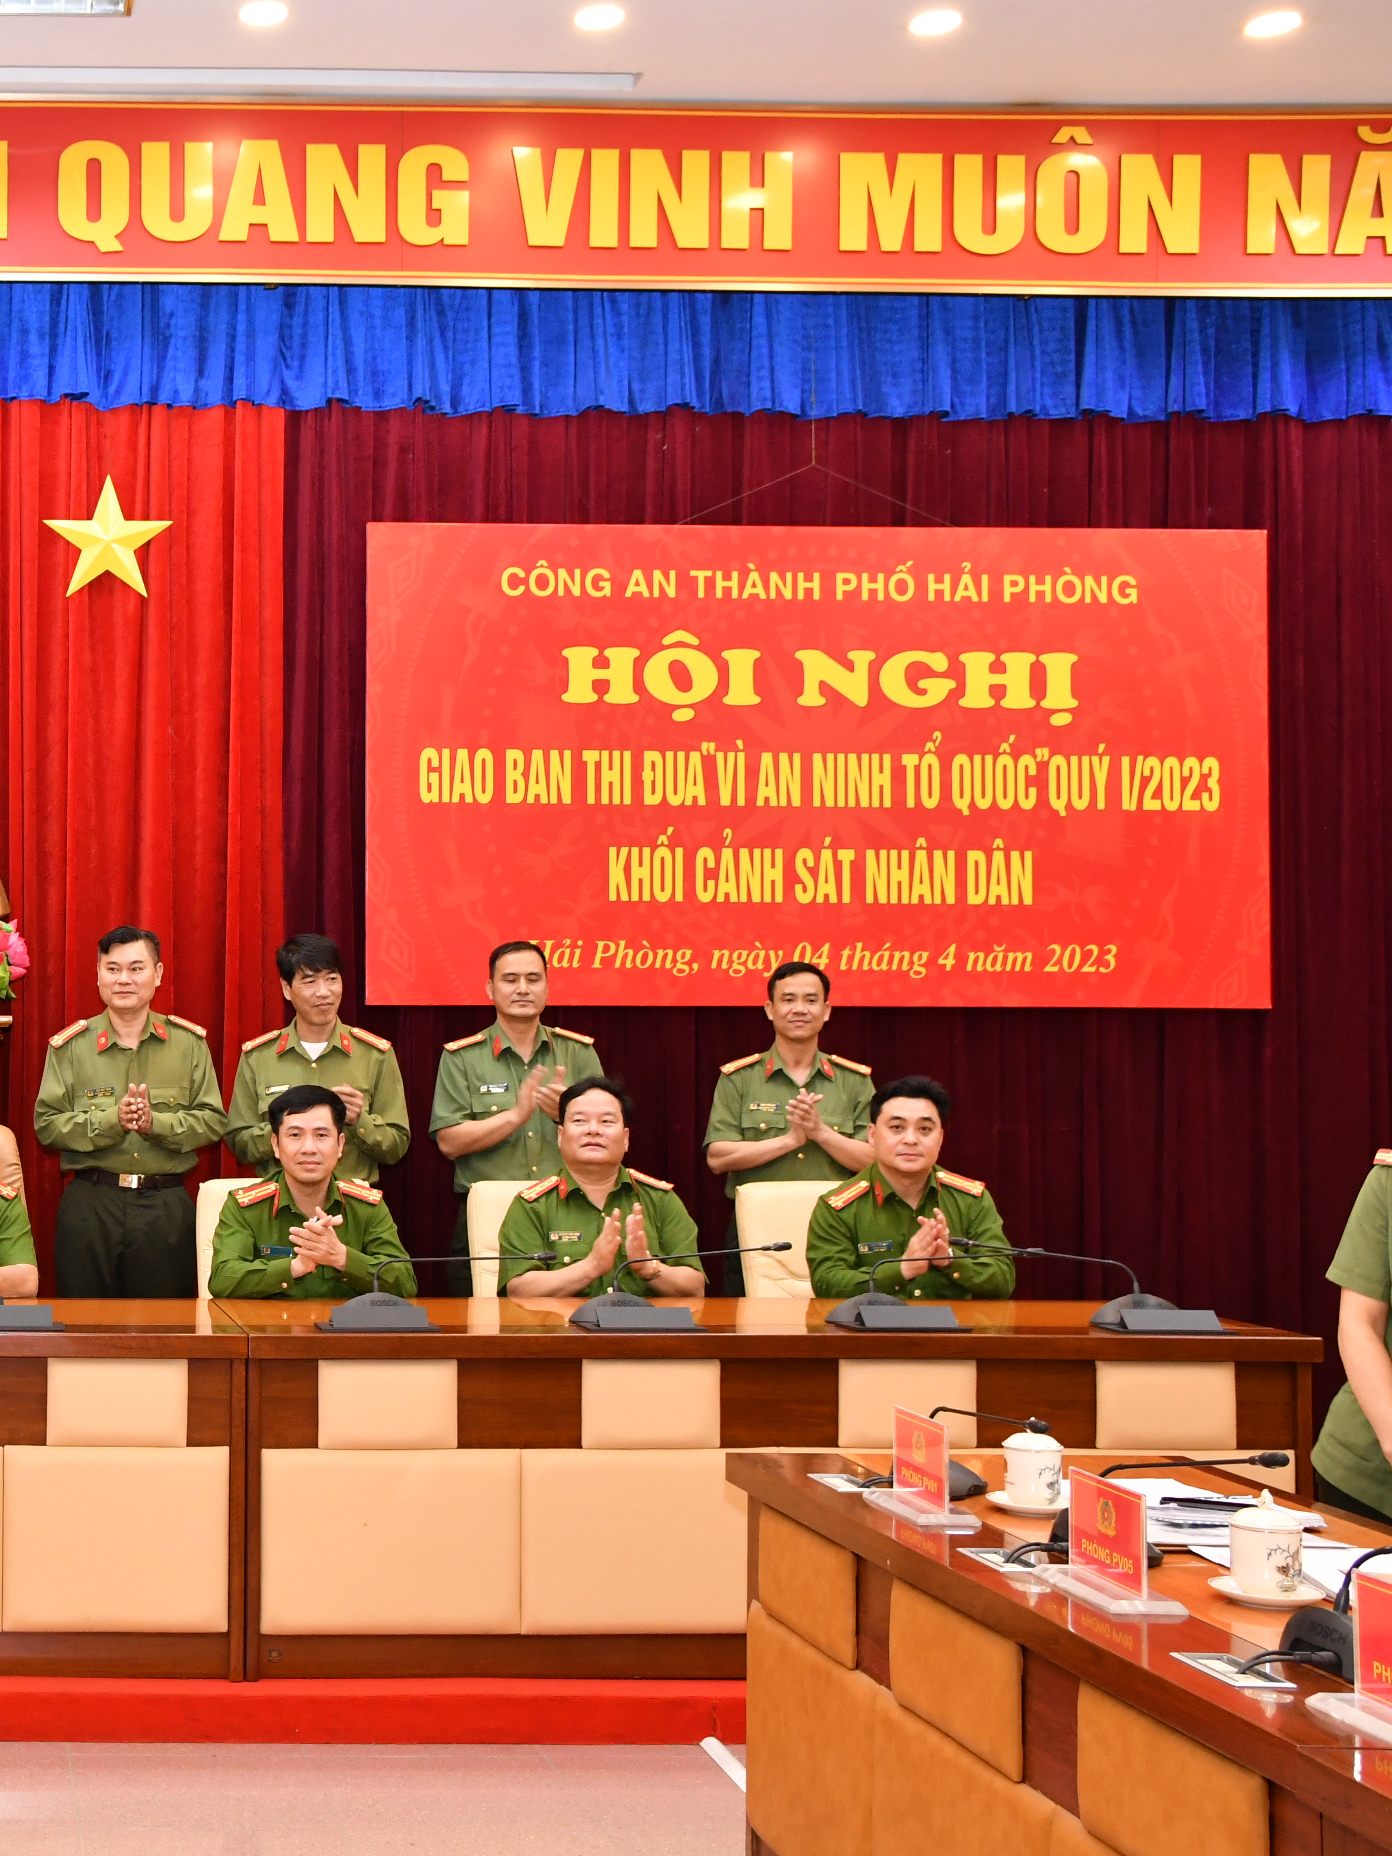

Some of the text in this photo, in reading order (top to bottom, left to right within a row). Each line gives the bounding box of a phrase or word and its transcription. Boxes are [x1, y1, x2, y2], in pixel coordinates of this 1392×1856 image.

[57, 139, 470, 254] QUANG
[512, 146, 794, 251] VINH
[839, 126, 1201, 255] MUÔN
[501, 559, 1139, 605] CÔNG AN THÀNH PHỐ HẢI PHÒNG
[560, 629, 1079, 727] HỘI NGHỊ
[419, 746, 494, 805] GIAO
[505, 748, 572, 805] BAN
[582, 749, 632, 806] THI
[642, 750, 706, 807] ĐUA
[756, 752, 801, 807] AN
[813, 752, 891, 808] NINH
[902, 730, 942, 809] TỔ
[1048, 743, 1111, 817] QUÝ
[1121, 754, 1221, 812] I/2023
[608, 826, 1033, 906] KHỐI CẢNH SÁT NHÂN DÂN
[592, 939, 699, 977] Phòng,
[710, 941, 784, 977] ngày
[793, 941, 830, 970] 04
[840, 941, 930, 979] tháng
[938, 943, 957, 972] 4
[966, 944, 1033, 972] năm
[1043, 943, 1118, 973] 2023
[610, 1299, 639, 1307] BOSCH
[1081, 1538, 1134, 1575] PHÒNG PV05
